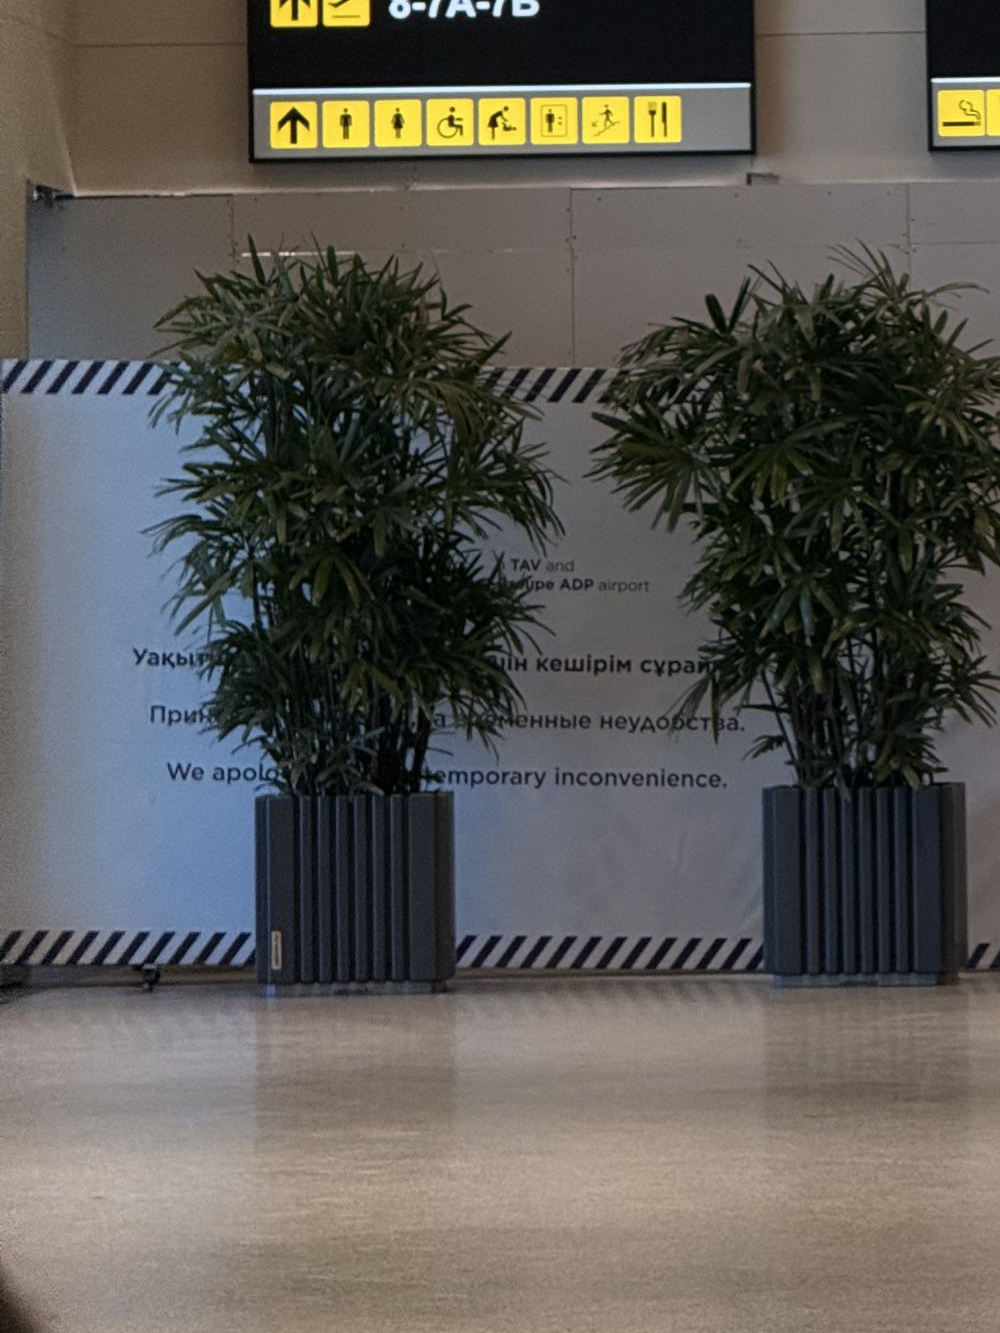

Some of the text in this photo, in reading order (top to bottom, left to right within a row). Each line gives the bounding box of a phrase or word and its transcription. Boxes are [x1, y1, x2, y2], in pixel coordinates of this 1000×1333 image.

[511, 559, 574, 571] TAV and
[560, 579, 594, 591] ADP
[598, 578, 649, 592] airport
[536, 655, 632, 677] кешірім
[167, 762, 727, 789] We apolo emporary inconvenience.
